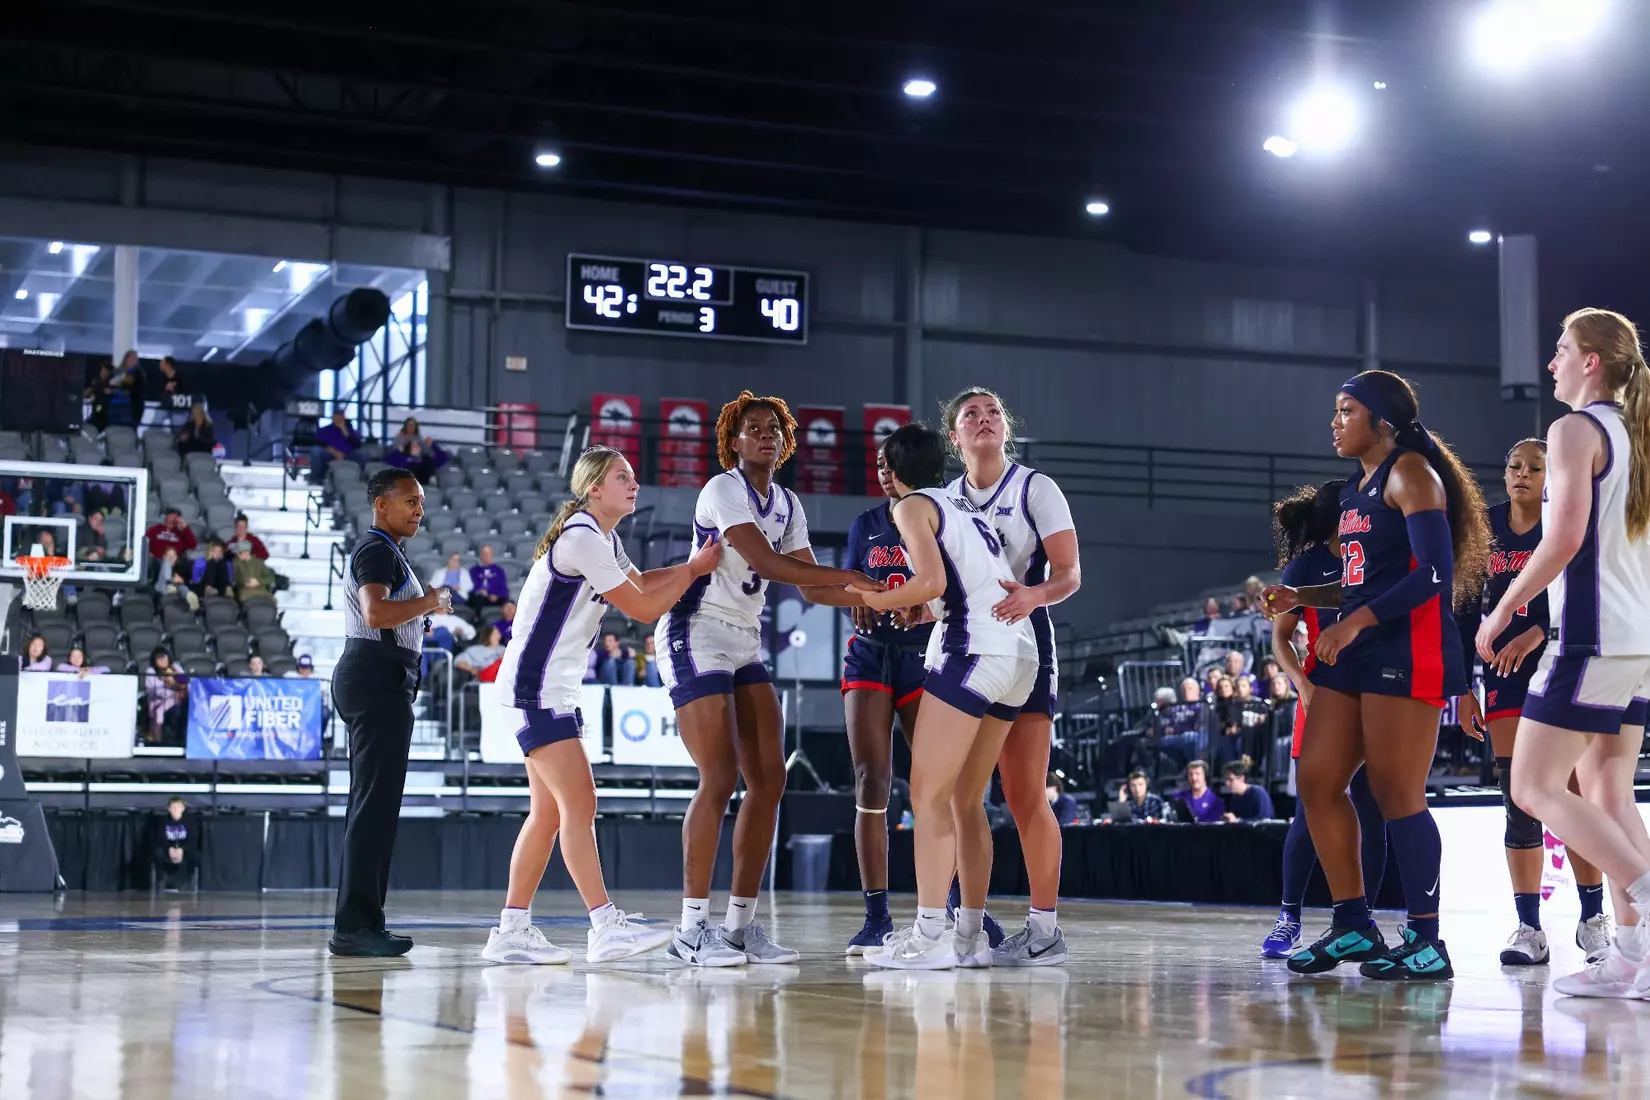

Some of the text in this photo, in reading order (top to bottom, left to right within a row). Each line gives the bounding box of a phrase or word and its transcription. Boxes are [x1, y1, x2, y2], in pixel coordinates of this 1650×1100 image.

[581, 264, 620, 282] HOME
[648, 264, 713, 300] 22.2
[755, 279, 798, 296] GUEST
[658, 310, 695, 325] PERIOD
[699, 307, 715, 333] 3
[761, 298, 799, 331] 40
[172, 394, 192, 408] 101
[971, 517, 1002, 559] 6
[868, 546, 890, 569] Ole
[243, 695, 303, 711] UNITED
[245, 711, 301, 729] FIBER
